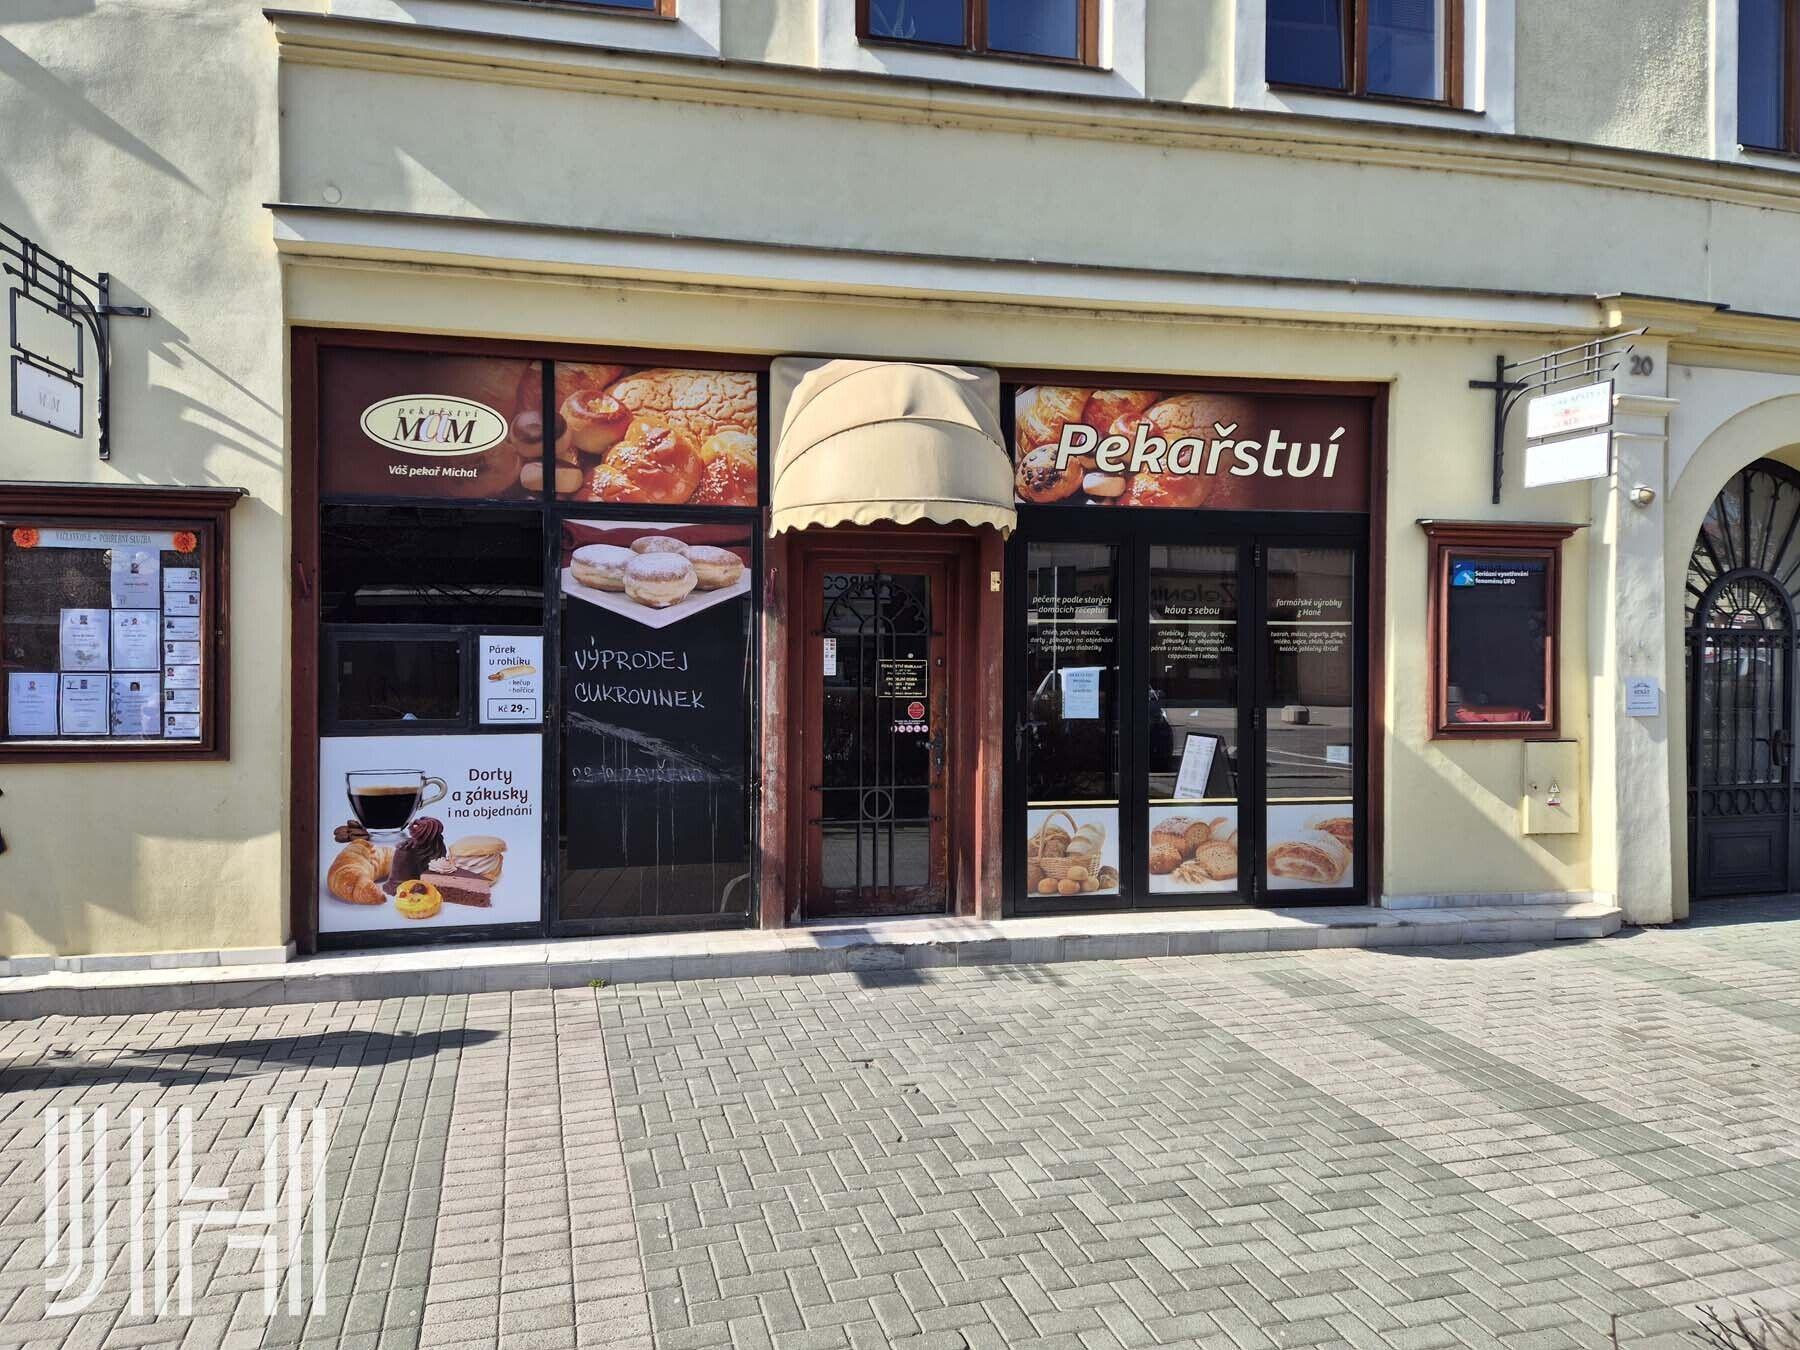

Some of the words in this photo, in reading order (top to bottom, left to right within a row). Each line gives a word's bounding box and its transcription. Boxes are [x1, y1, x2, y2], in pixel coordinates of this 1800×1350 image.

[1629, 354, 1653, 377] 20
[1055, 422, 1345, 478] Pekařství
[389, 464, 407, 475] Váš
[409, 466, 440, 477] pekař
[442, 467, 478, 478] Michal
[1032, 595, 1061, 604] pečeme
[1062, 595, 1084, 605] podle
[1084, 595, 1112, 606] starých
[1164, 604, 1186, 615] káva
[1188, 607, 1193, 615] s
[1194, 605, 1220, 615] sebou
[489, 645, 516, 654] Párek
[574, 635, 688, 672] VÝPRODEJ
[497, 657, 531, 666] rohlíku
[574, 682, 705, 708] CUKROVINEK
[498, 704, 508, 712] Kč
[510, 704, 529, 714] 29,-
[469, 768, 512, 785] Dorty
[452, 791, 461, 801] a
[465, 786, 528, 805] zákusky
[454, 809, 470, 818] na
[473, 804, 532, 820] objednání
